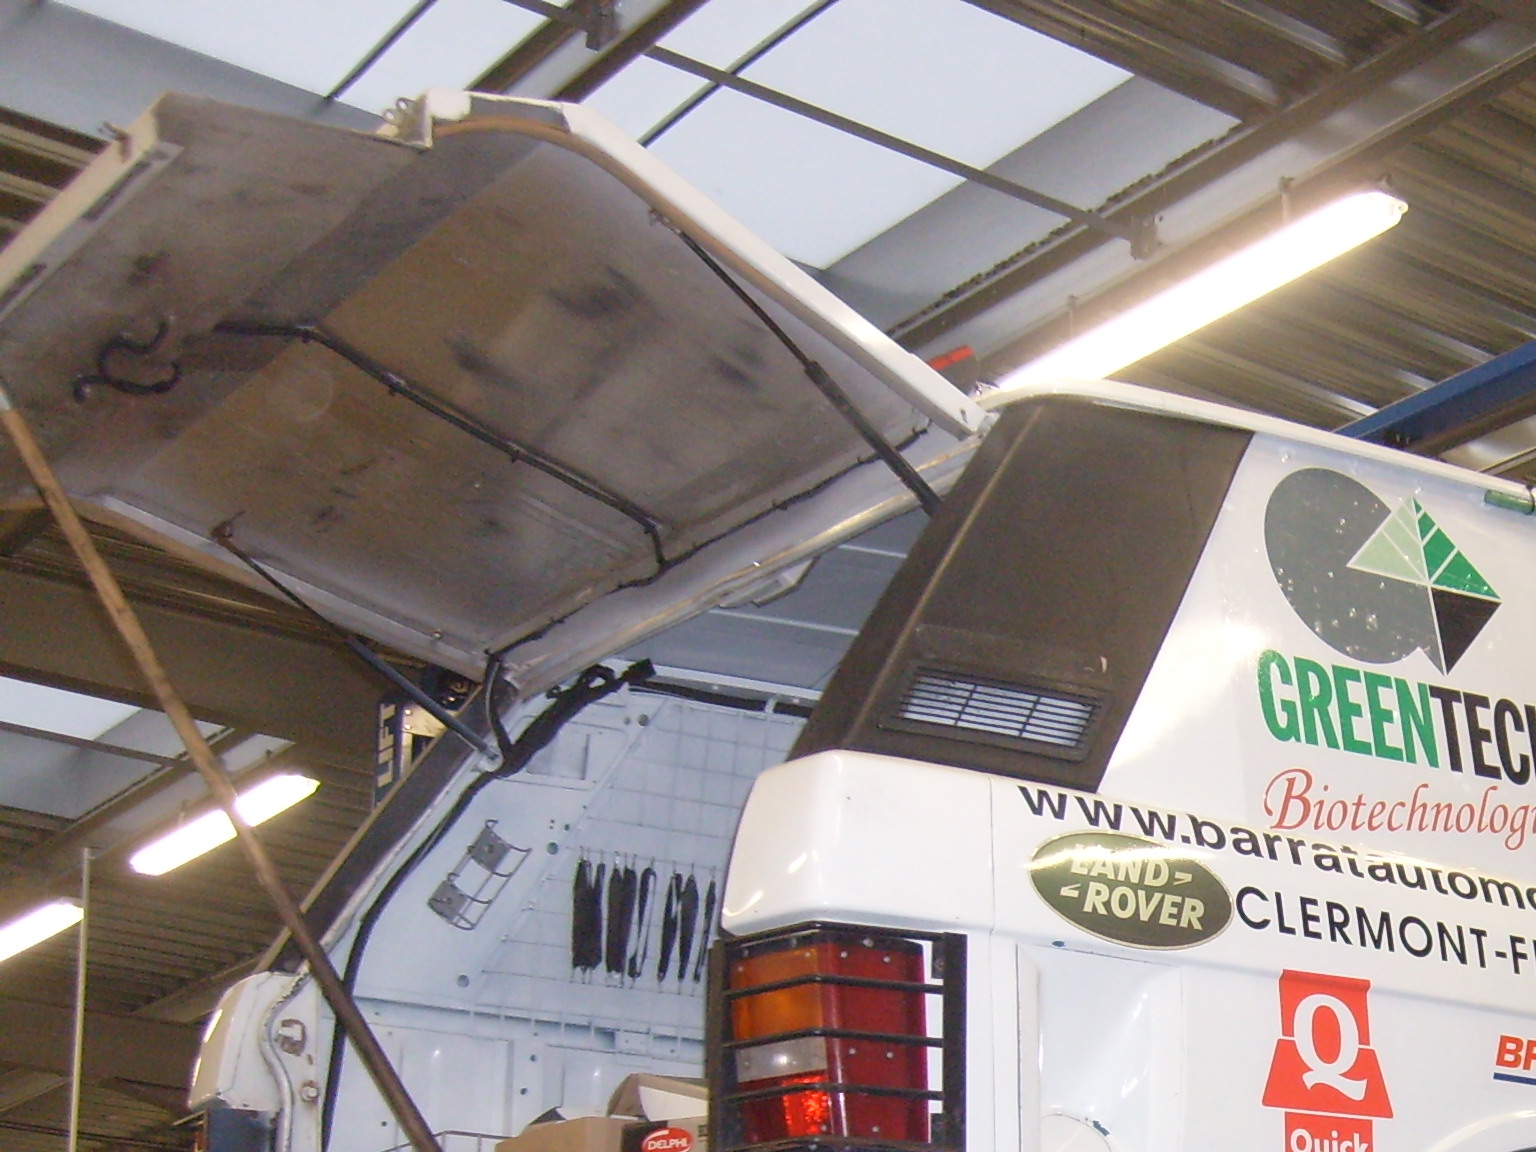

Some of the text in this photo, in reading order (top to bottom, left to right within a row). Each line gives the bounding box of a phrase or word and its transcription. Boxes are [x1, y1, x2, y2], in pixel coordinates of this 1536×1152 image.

[377, 703, 396, 788] LIFT
[1069, 843, 1170, 888] LAND
[1082, 882, 1206, 931] ROVER
[1293, 993, 1368, 1101] Q
[647, 1137, 688, 1151] DELPHI
